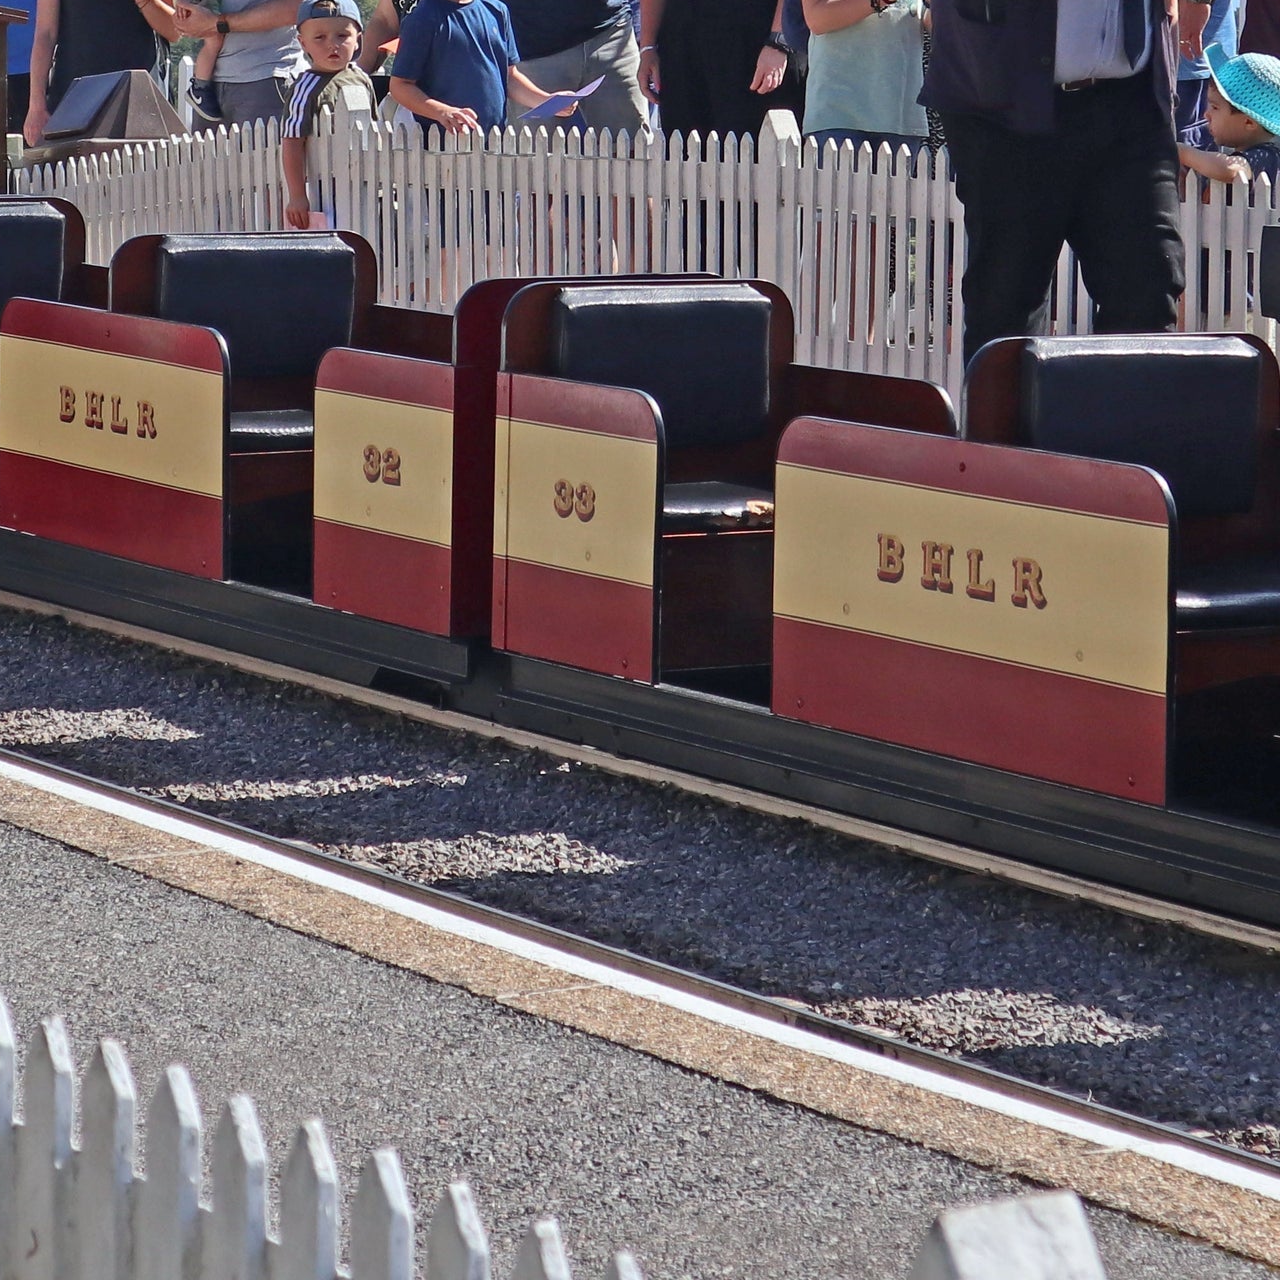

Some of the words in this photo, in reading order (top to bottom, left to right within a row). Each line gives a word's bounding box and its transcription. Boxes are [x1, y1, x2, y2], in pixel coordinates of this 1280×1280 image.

[58, 384, 157, 439] BHLR
[363, 444, 402, 486] 32
[553, 478, 596, 522] 33
[876, 532, 1048, 609] BHLR
